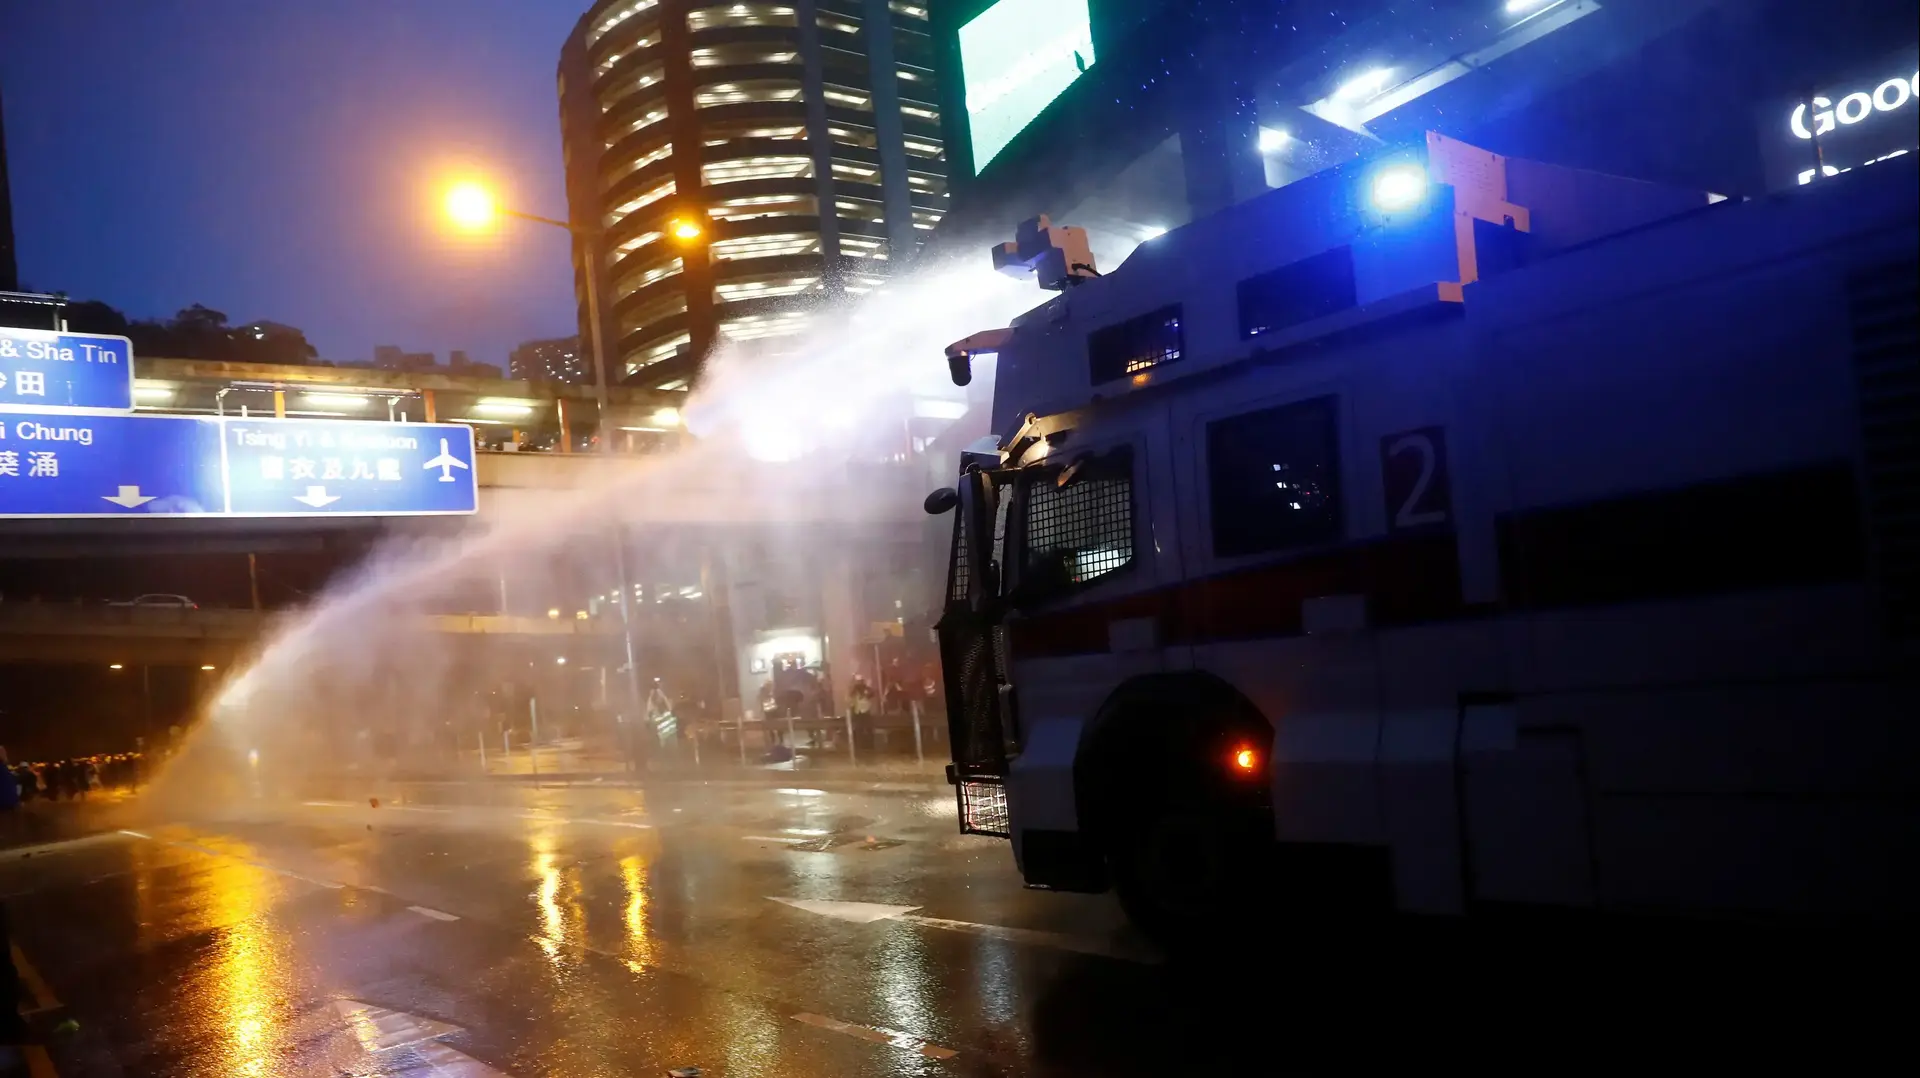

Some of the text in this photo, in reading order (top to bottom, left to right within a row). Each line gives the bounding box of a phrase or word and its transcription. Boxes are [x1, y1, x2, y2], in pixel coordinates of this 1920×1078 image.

[1790, 70, 1919, 139] Goo
[0, 339, 117, 364] & Sha Tin
[0, 370, 45, 397] 田
[16, 421, 93, 446] Chung
[232, 428, 286, 450] Tsing
[261, 455, 402, 480] 衣及九
[1388, 434, 1446, 528] 2
